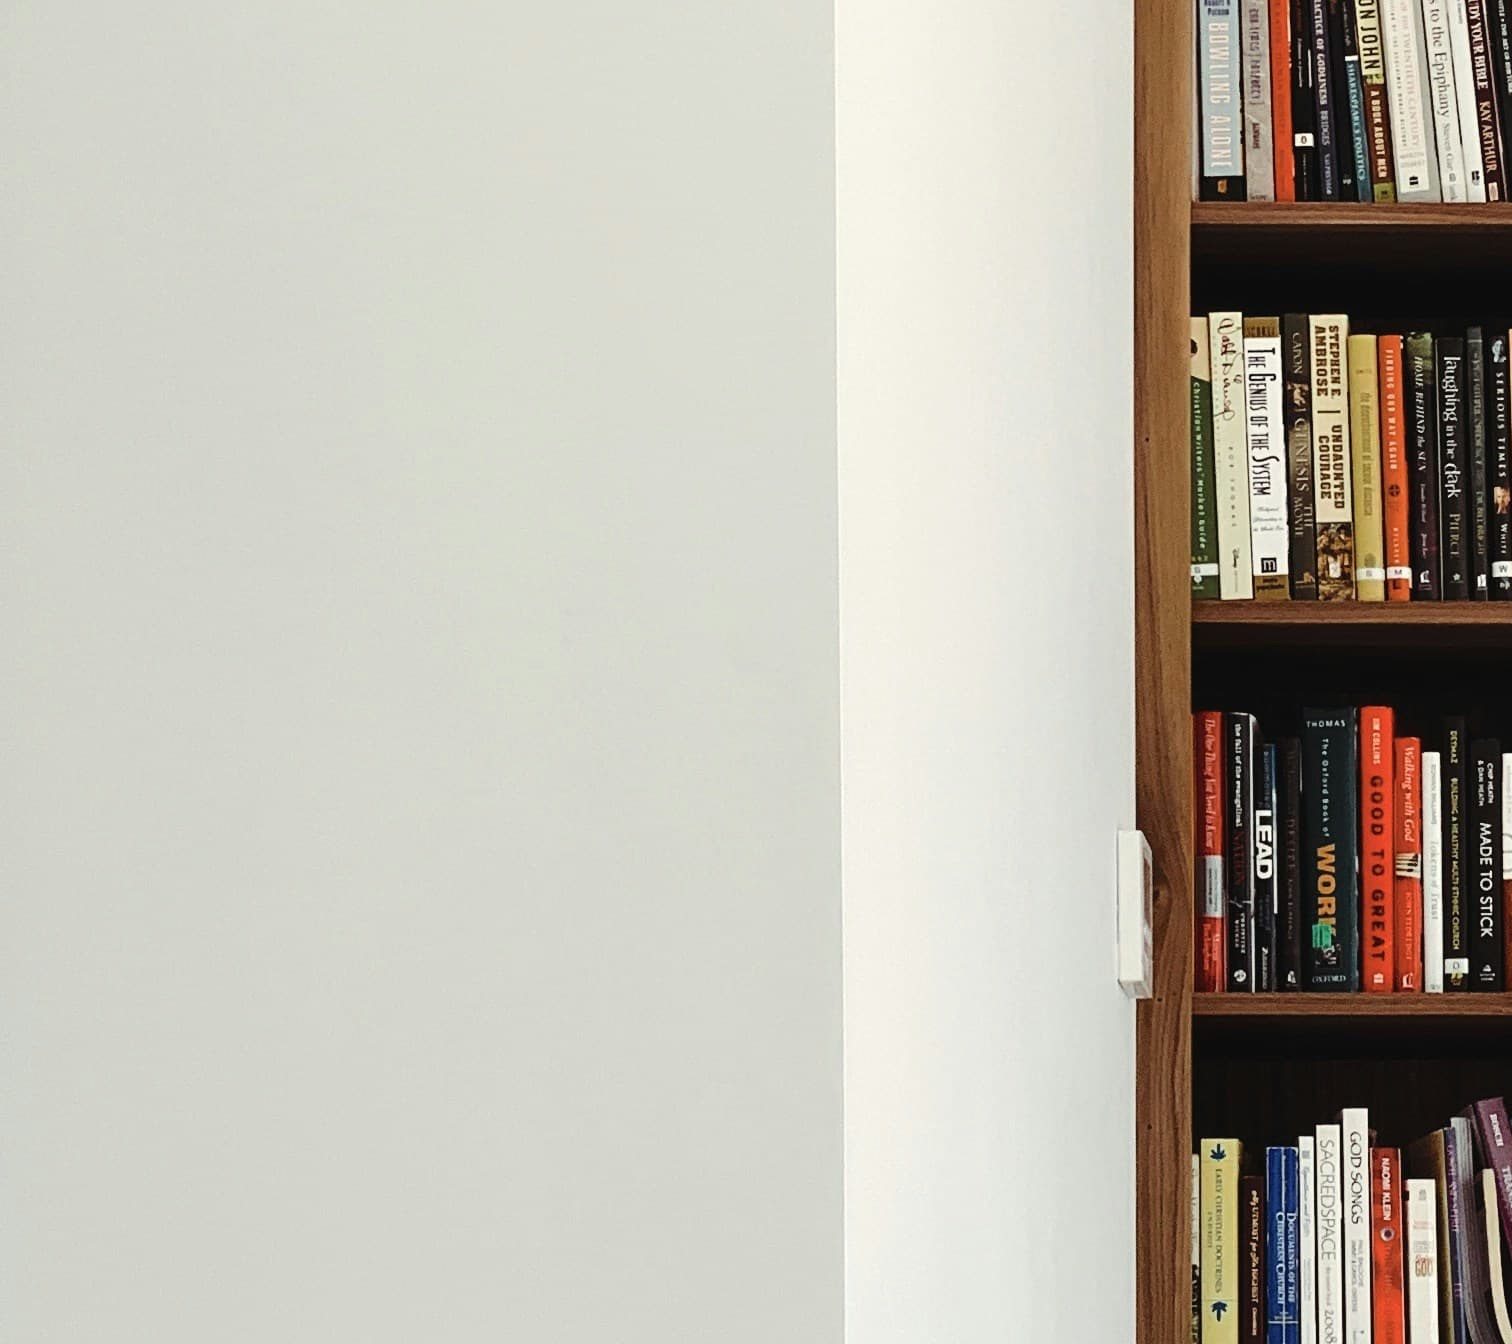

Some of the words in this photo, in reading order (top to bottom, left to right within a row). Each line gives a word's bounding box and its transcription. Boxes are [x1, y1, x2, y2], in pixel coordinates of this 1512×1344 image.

[1208, 23, 1230, 103] BOWLING
[1371, 99, 1383, 123] BOOK
[1479, 101, 1492, 121] KAY
[1210, 115, 1232, 167] ALONE
[1373, 126, 1385, 155] ABOUT
[1482, 125, 1497, 173] ARTHUR
[1377, 159, 1387, 177] MEN
[1315, 325, 1328, 397] AMBROSE
[1328, 325, 1340, 378] STEPHEN
[1330, 382, 1340, 400] E.
[1442, 356, 1461, 421] laughing
[1250, 415, 1267, 429] OF
[1446, 425, 1457, 437] in
[1319, 435, 1331, 500] COURAGE
[1331, 425, 1345, 509] UNDAUNTED
[1445, 440, 1457, 460] the
[1444, 463, 1461, 499] dark
[1448, 513, 1461, 559] PIERCE
[1370, 775, 1382, 836] GOOD
[1256, 810, 1272, 880] LEAD
[1372, 849, 1383, 876] TO
[1479, 823, 1492, 865] MADE
[1480, 870, 1492, 891] TO
[1372, 889, 1385, 962] GREAT
[1480, 896, 1492, 937] STICK
[1350, 1132, 1362, 1168] GOD
[1350, 1171, 1363, 1224] SONGS
[1324, 1309, 1337, 1344] 2008
